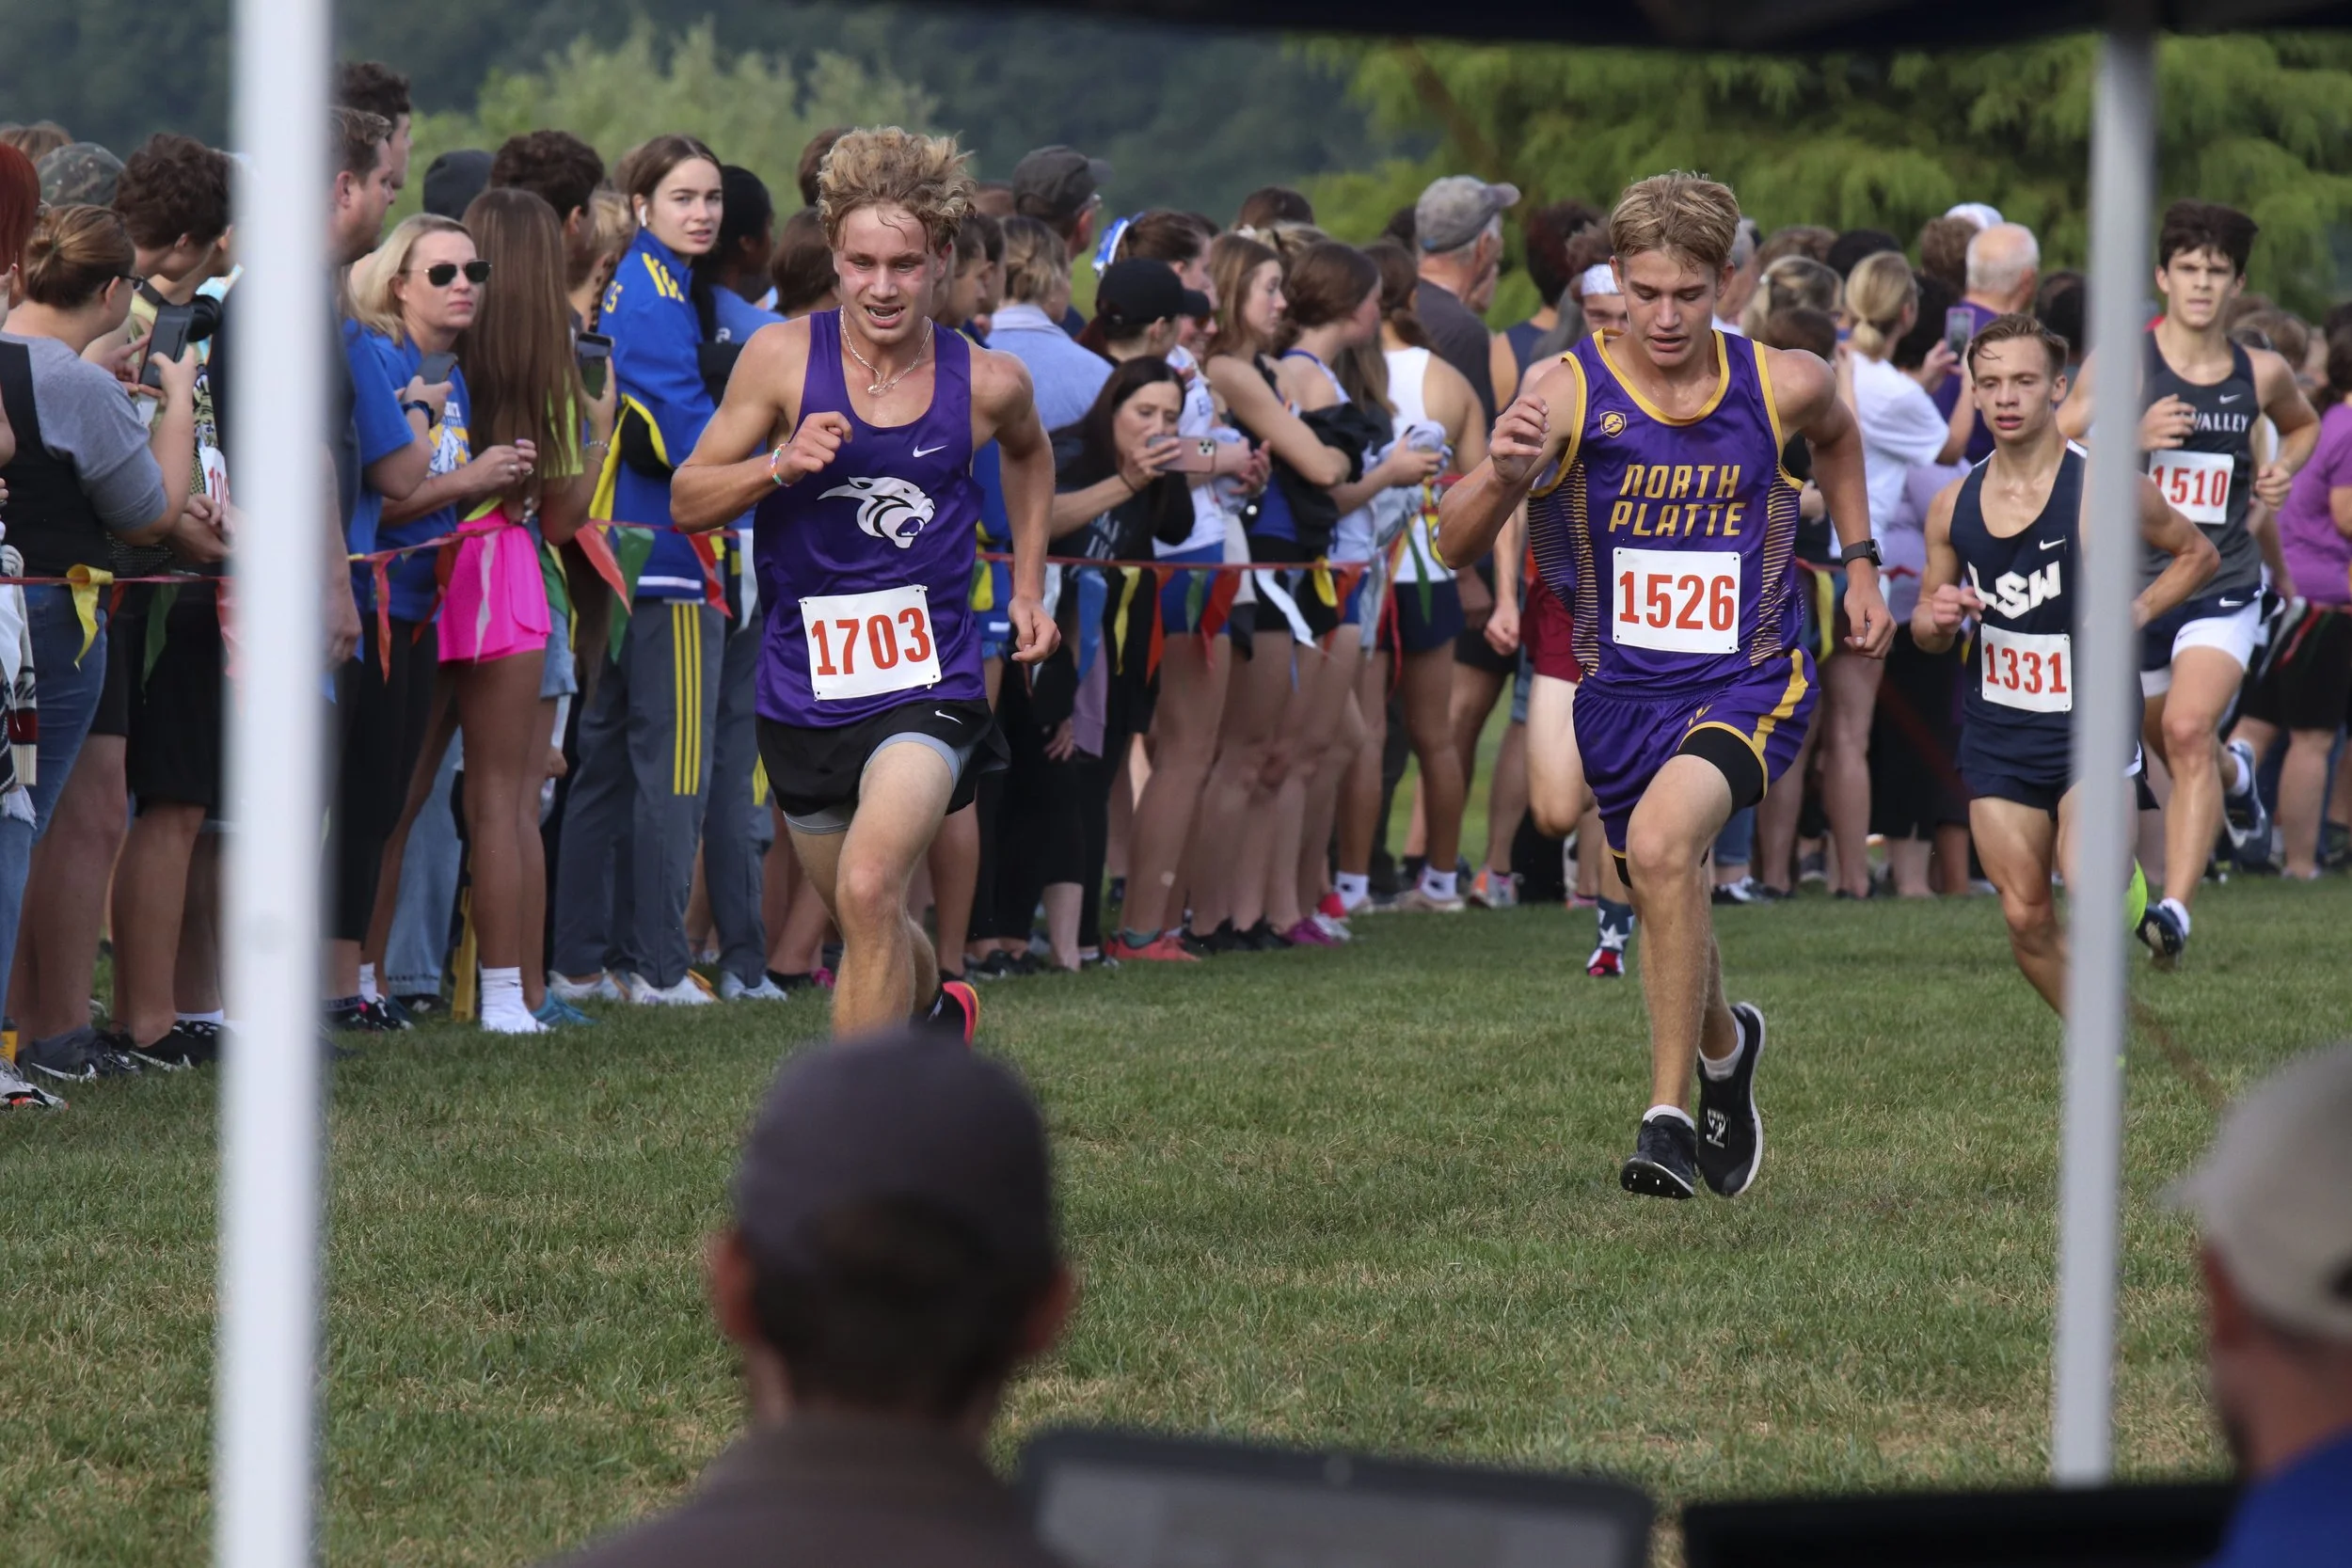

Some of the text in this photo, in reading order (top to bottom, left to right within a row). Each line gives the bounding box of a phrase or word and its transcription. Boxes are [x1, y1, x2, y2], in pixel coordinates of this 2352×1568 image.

[2190, 412, 2250, 433] VALLEY
[1619, 464, 1741, 499] NORTH
[2152, 465, 2229, 508] 1510
[1608, 500, 1747, 537] PLATTE
[1619, 570, 1736, 631] 1526
[1967, 560, 2062, 620] LSW
[811, 607, 931, 676] 1703
[1985, 641, 2067, 694] 1331
